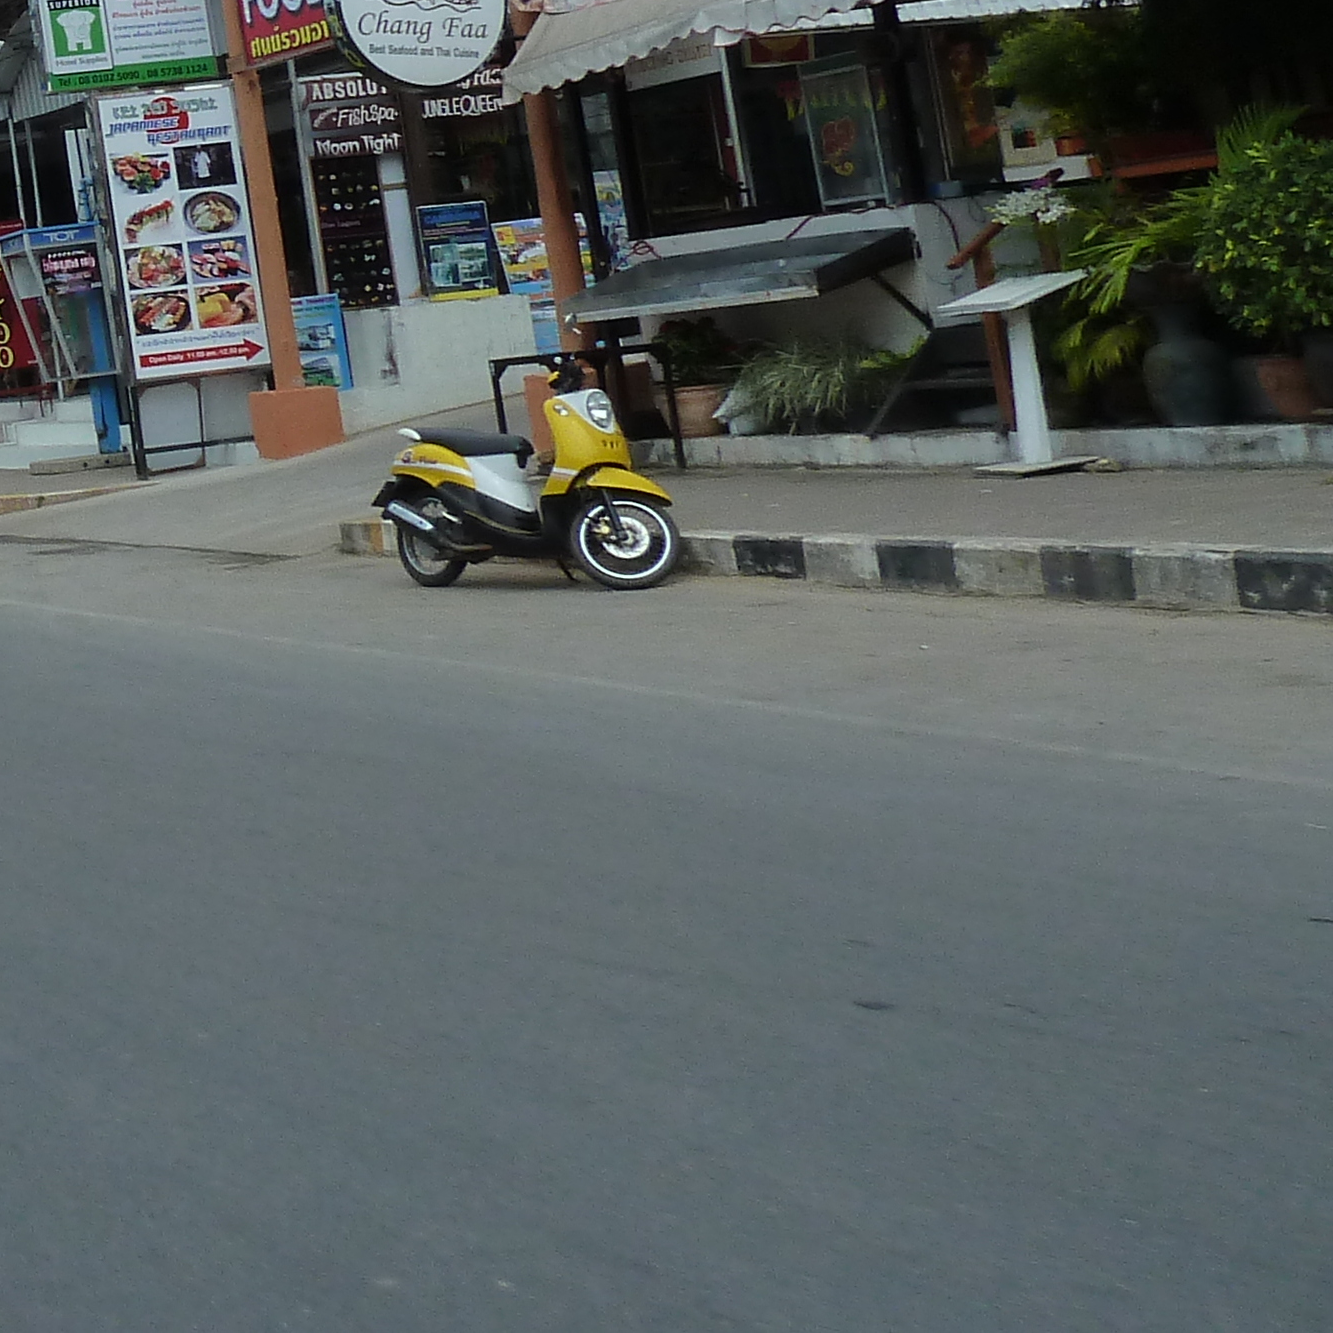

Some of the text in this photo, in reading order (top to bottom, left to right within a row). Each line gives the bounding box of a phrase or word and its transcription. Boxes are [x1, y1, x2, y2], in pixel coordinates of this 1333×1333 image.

[358, 10, 489, 44] Chang Faa
[369, 44, 479, 59] Best Seafood and Thai Cuisine
[147, 125, 233, 146] RESTAURANT
[43, 229, 80, 242] TOT
